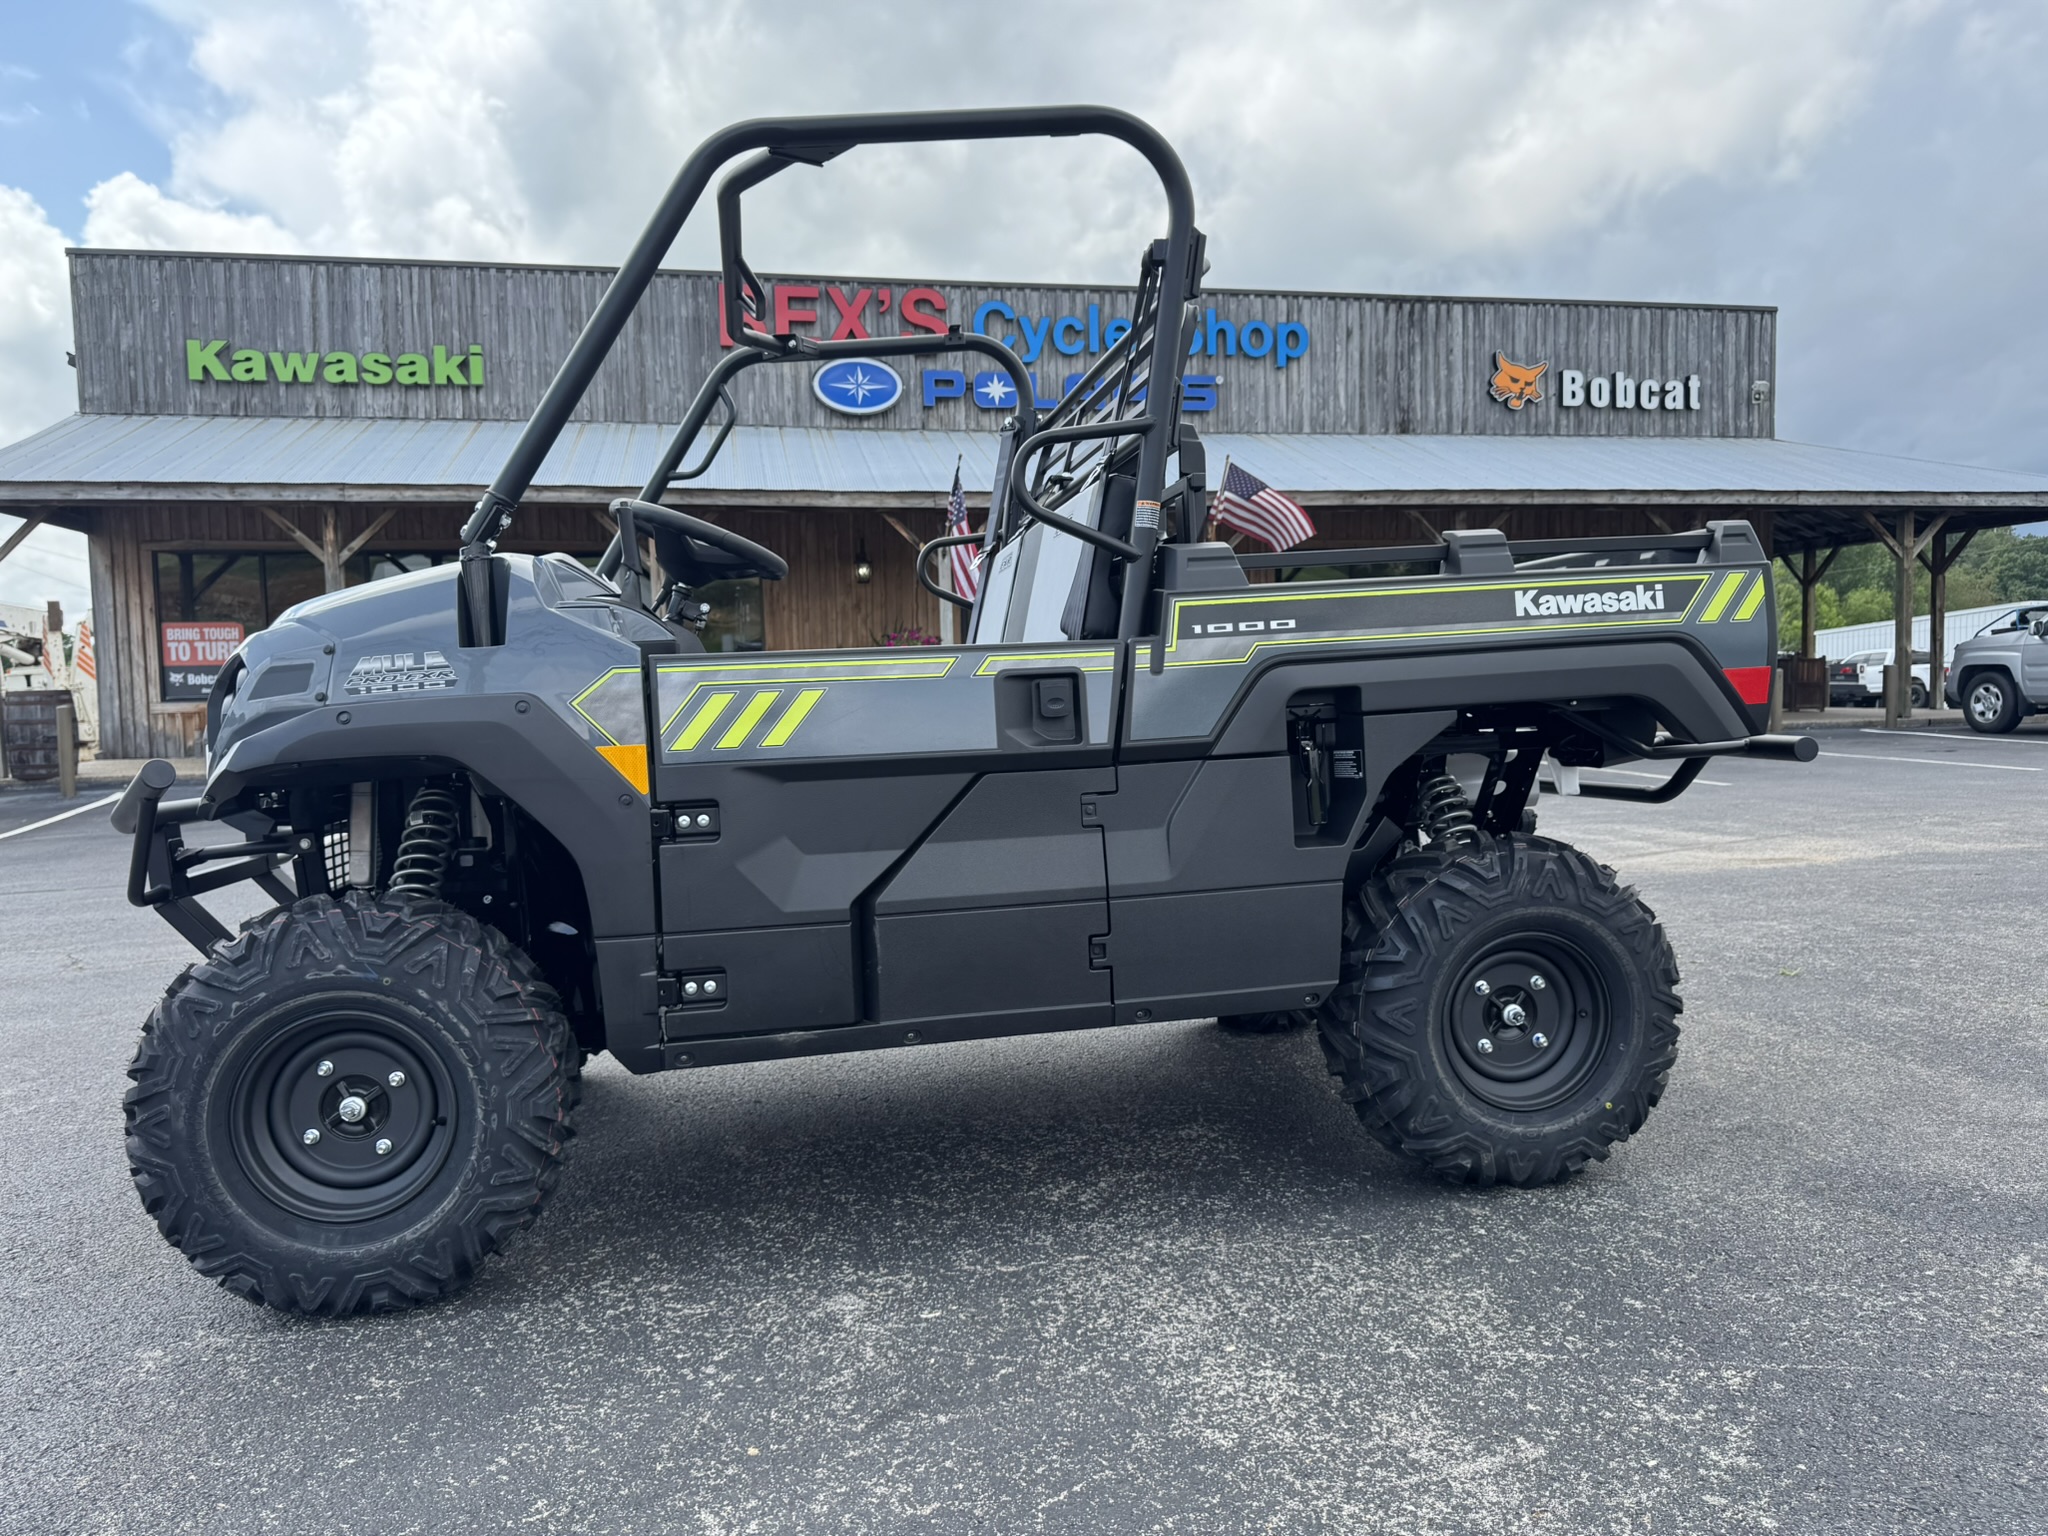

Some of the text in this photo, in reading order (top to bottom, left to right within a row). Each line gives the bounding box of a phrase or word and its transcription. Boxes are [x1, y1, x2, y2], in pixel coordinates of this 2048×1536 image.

[1188, 308, 1309, 368] hop
[186, 339, 484, 385] Kawasaki
[1562, 369, 1700, 410] Bobcat
[1514, 584, 1664, 617] Kawasaki
[166, 627, 239, 641] BRING TOUGH
[1192, 619, 1296, 634] 1000
[167, 641, 191, 662] TO
[349, 651, 453, 678] MULE
[187, 673, 218, 686] Bobc
